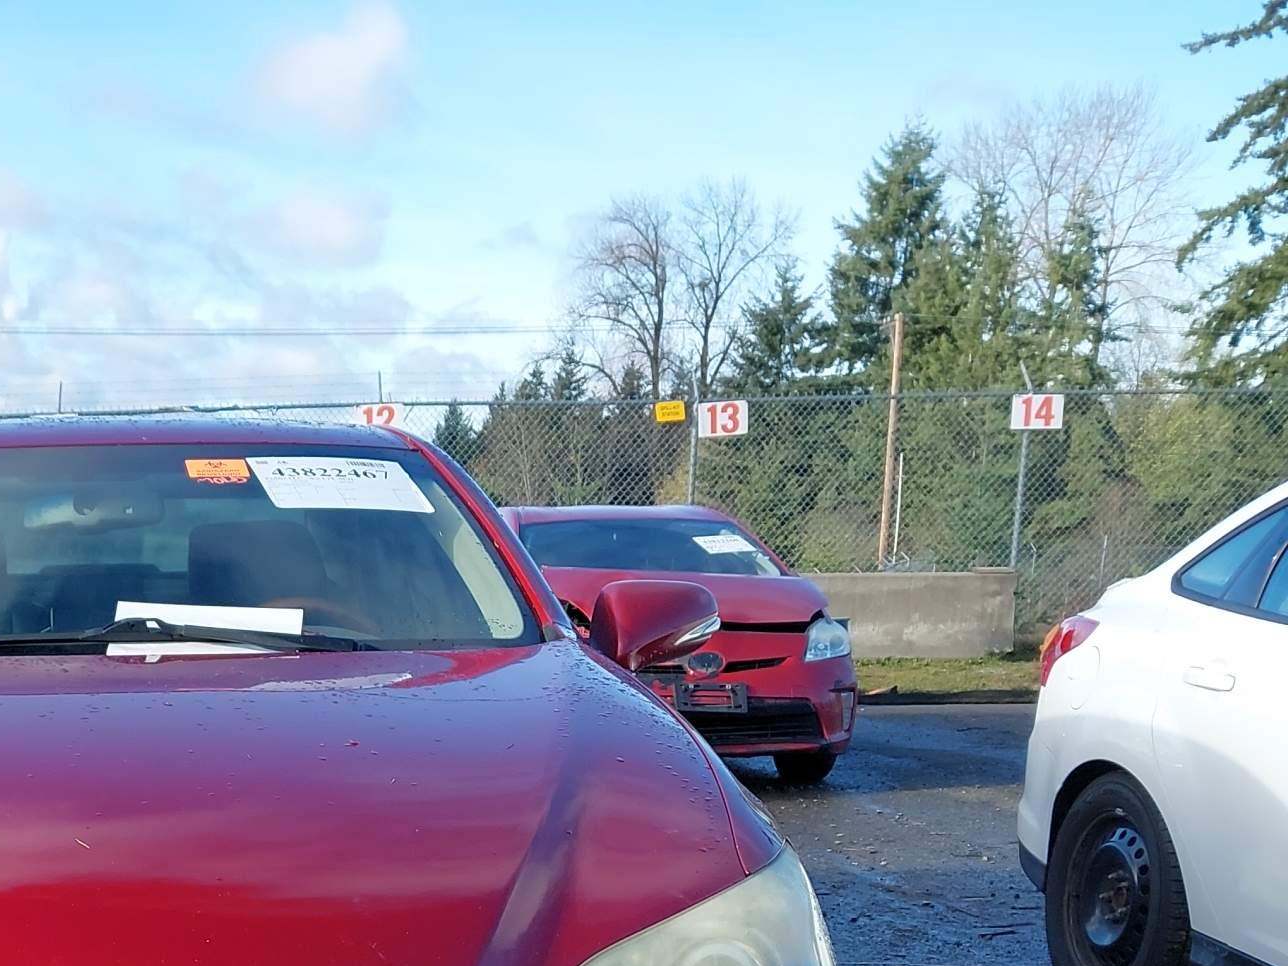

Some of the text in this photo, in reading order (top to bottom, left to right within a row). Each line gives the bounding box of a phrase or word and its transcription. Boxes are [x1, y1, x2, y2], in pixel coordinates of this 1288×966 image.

[362, 405, 396, 425] 12
[706, 402, 740, 434] 13
[1021, 396, 1054, 427] 14
[271, 466, 388, 480] 43822467
